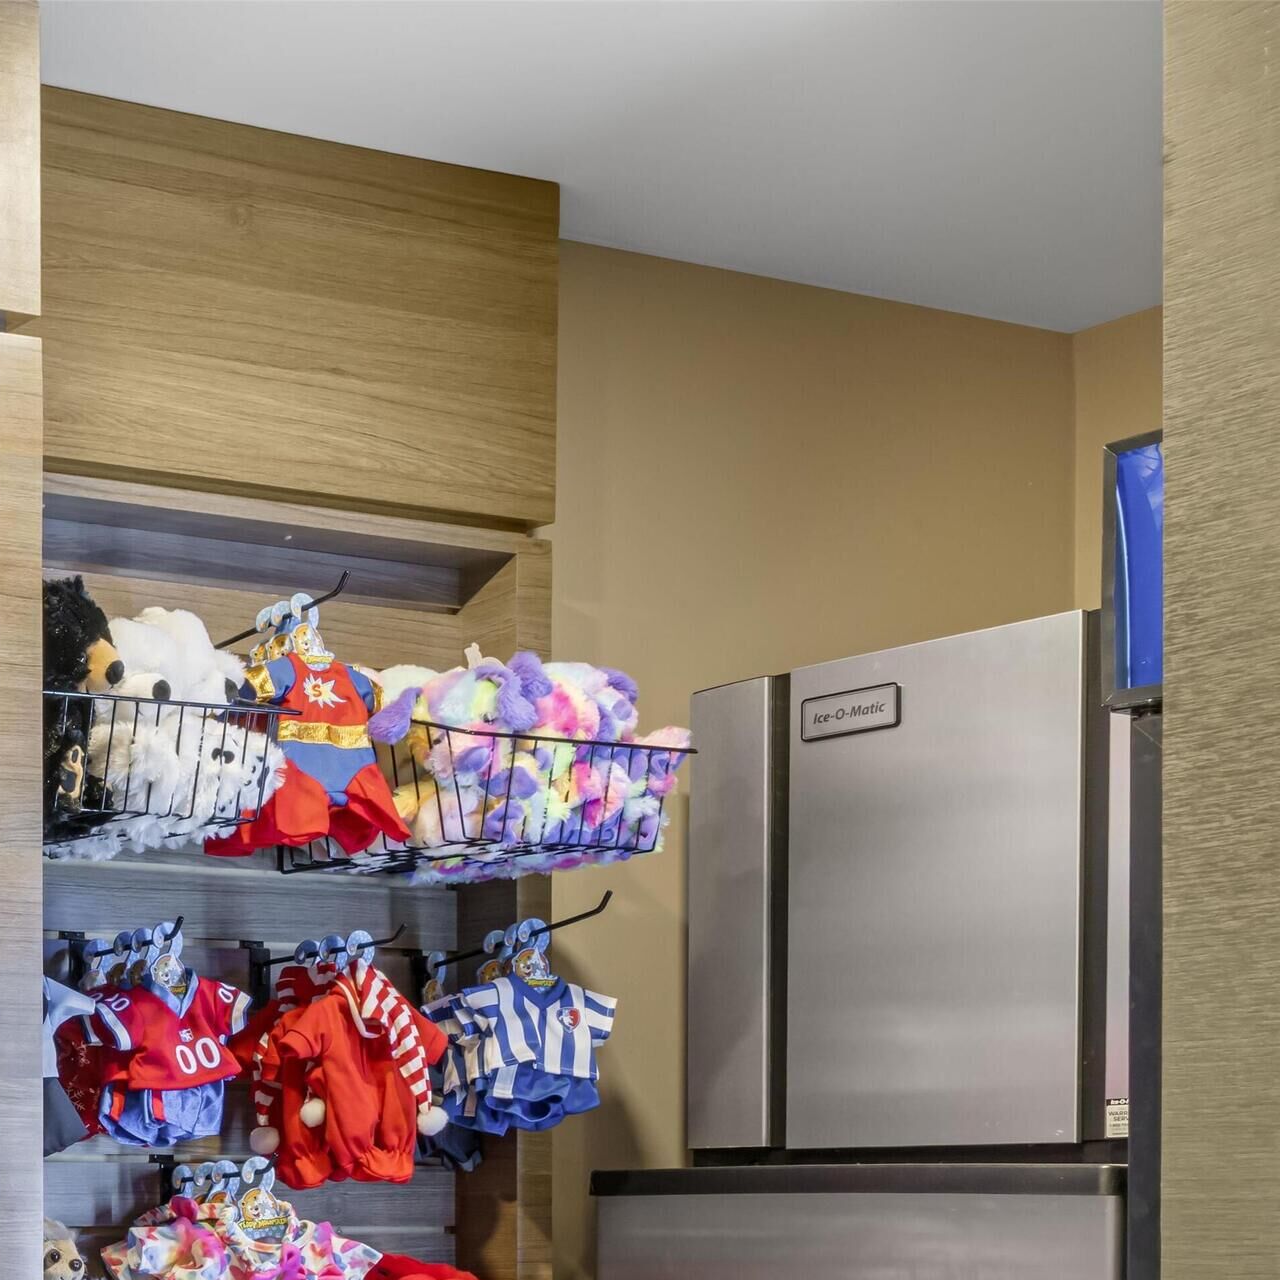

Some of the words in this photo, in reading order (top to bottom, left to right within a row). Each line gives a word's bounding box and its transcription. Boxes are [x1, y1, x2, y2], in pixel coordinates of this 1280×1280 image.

[311, 684, 322, 697] S
[813, 701, 886, 725] Ice-O-Matic
[175, 1037, 221, 1075] 00
